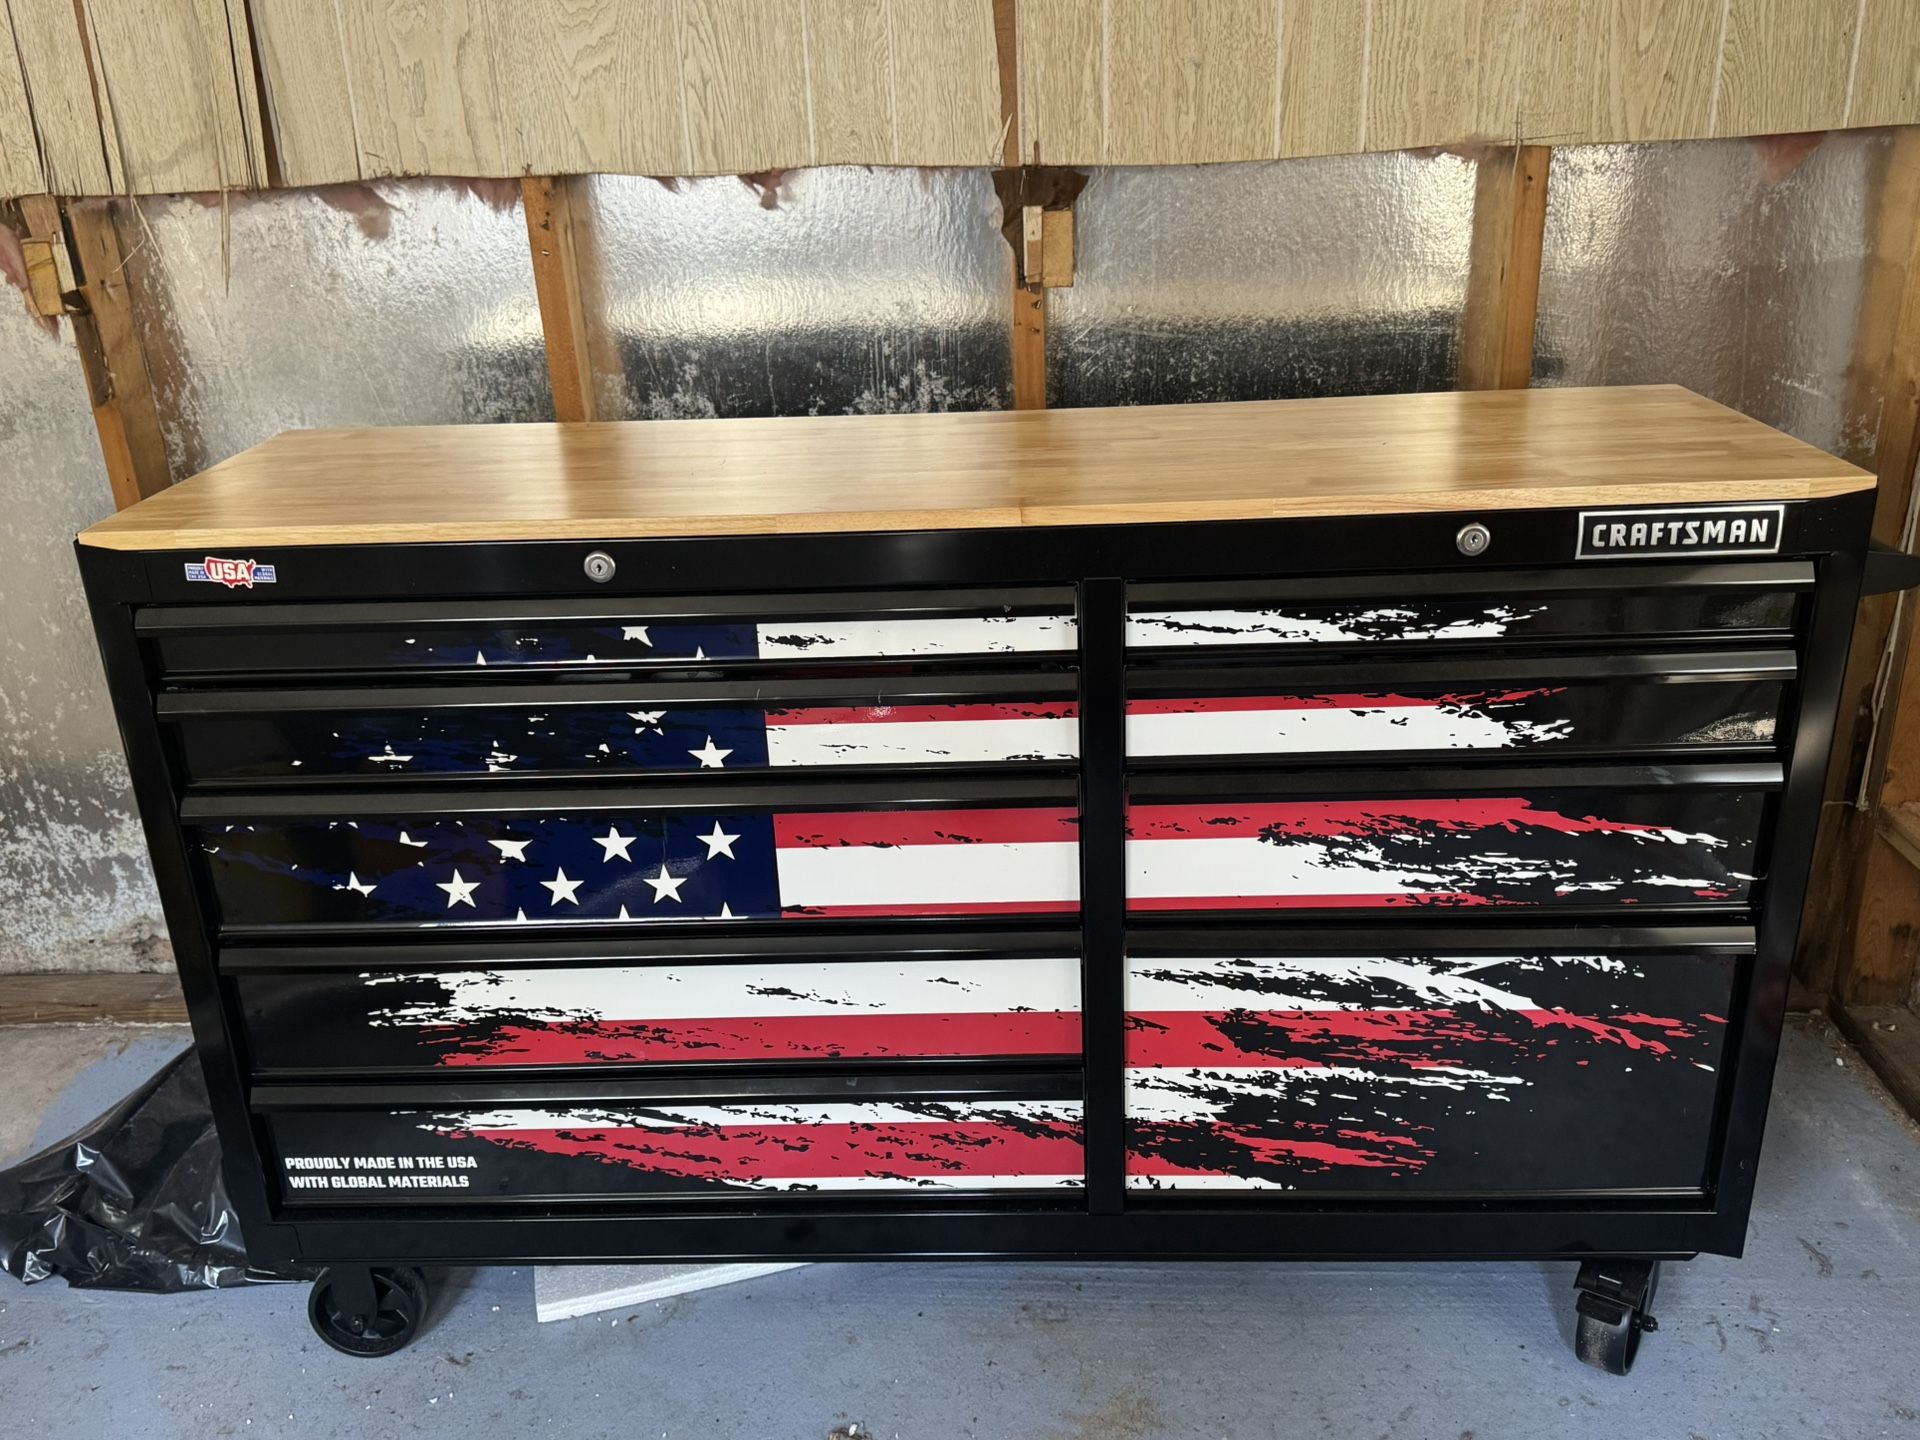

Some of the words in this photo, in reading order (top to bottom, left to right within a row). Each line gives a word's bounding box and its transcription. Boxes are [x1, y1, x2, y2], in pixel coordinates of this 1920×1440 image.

[1592, 518, 1769, 547] CRAFTSMAN
[209, 562, 251, 580] USA
[285, 1157, 350, 1169] PROUDLY
[353, 1157, 396, 1169] MADE
[398, 1157, 414, 1169] IN
[416, 1156, 445, 1168] THE
[447, 1156, 478, 1168] USA
[289, 1176, 329, 1188] WITH
[331, 1176, 386, 1188] GLOBAL
[388, 1175, 469, 1188] MATERIALS
